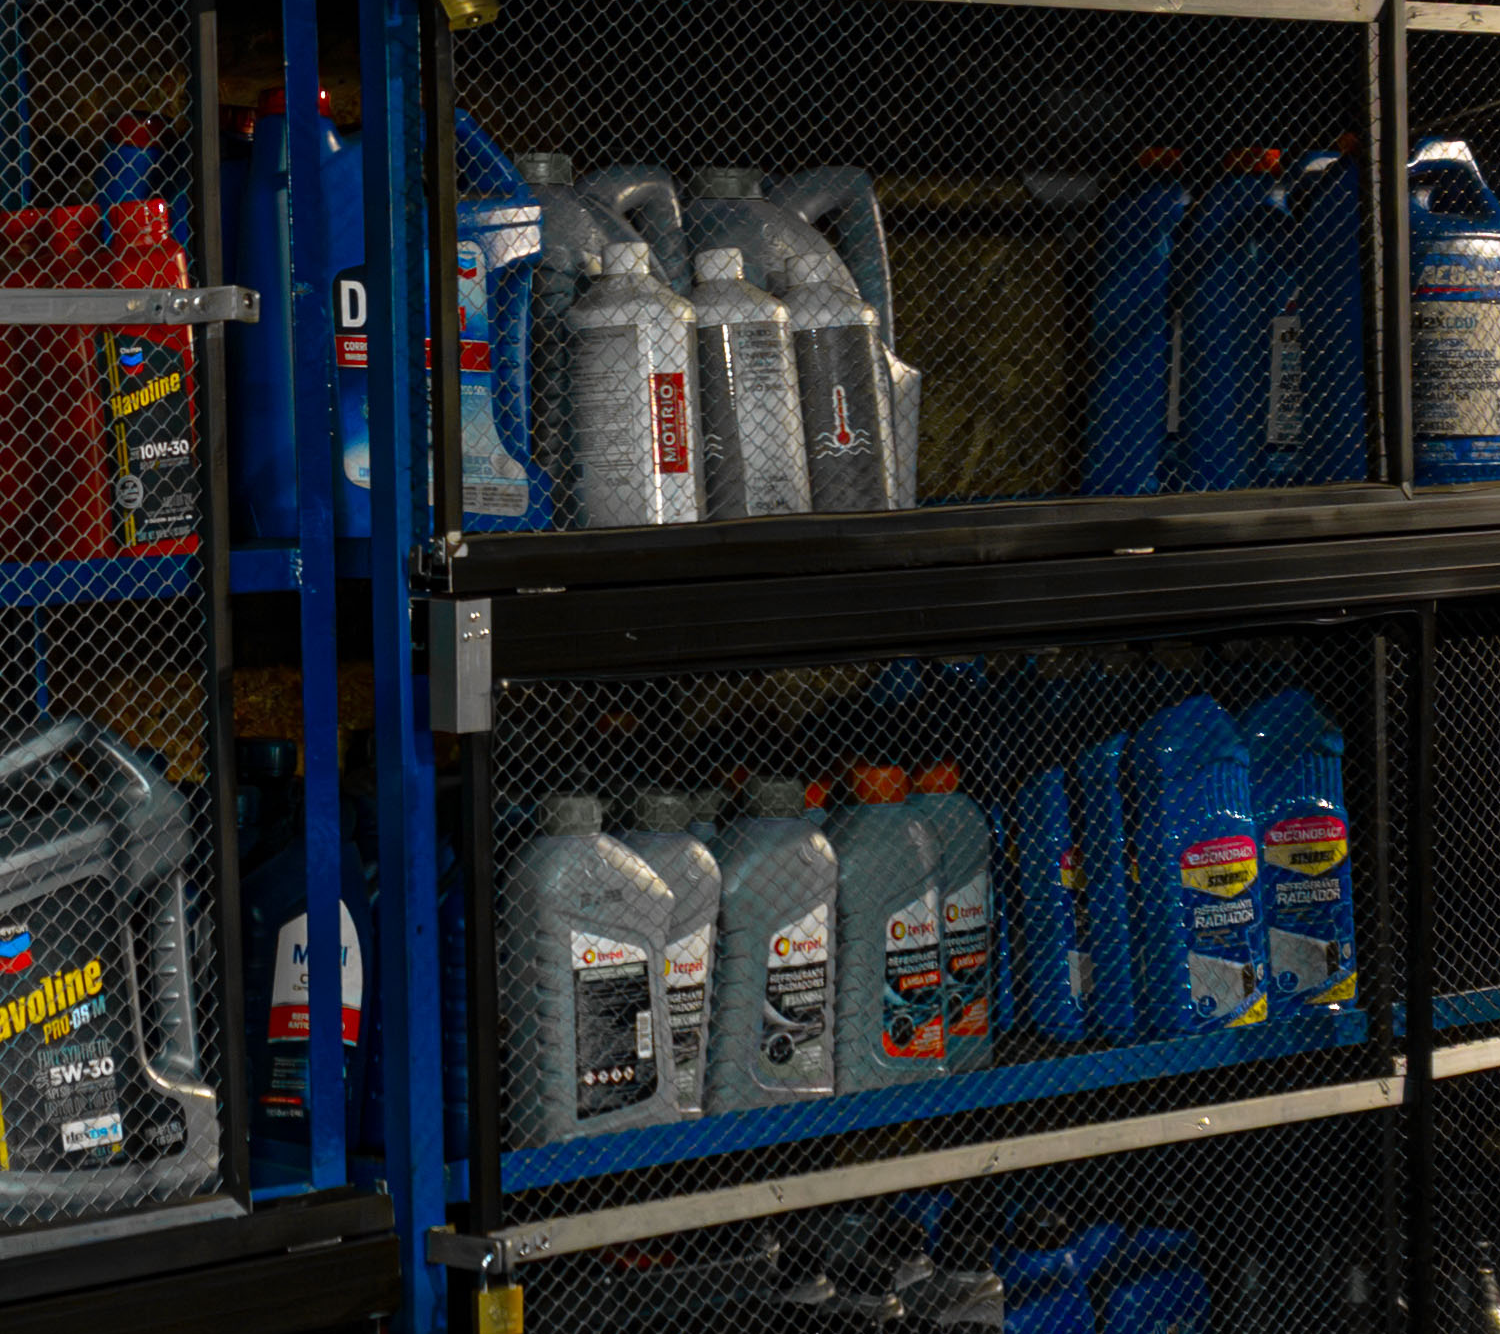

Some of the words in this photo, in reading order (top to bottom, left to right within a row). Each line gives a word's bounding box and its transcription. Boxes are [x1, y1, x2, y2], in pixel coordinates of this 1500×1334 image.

[110, 371, 182, 418] Havoline
[661, 383, 676, 463] MOTRIO
[139, 439, 190, 460] 10W-30
[792, 937, 822, 955] terpel
[673, 960, 704, 975] terpel
[49, 1056, 116, 1088] 5W-30
